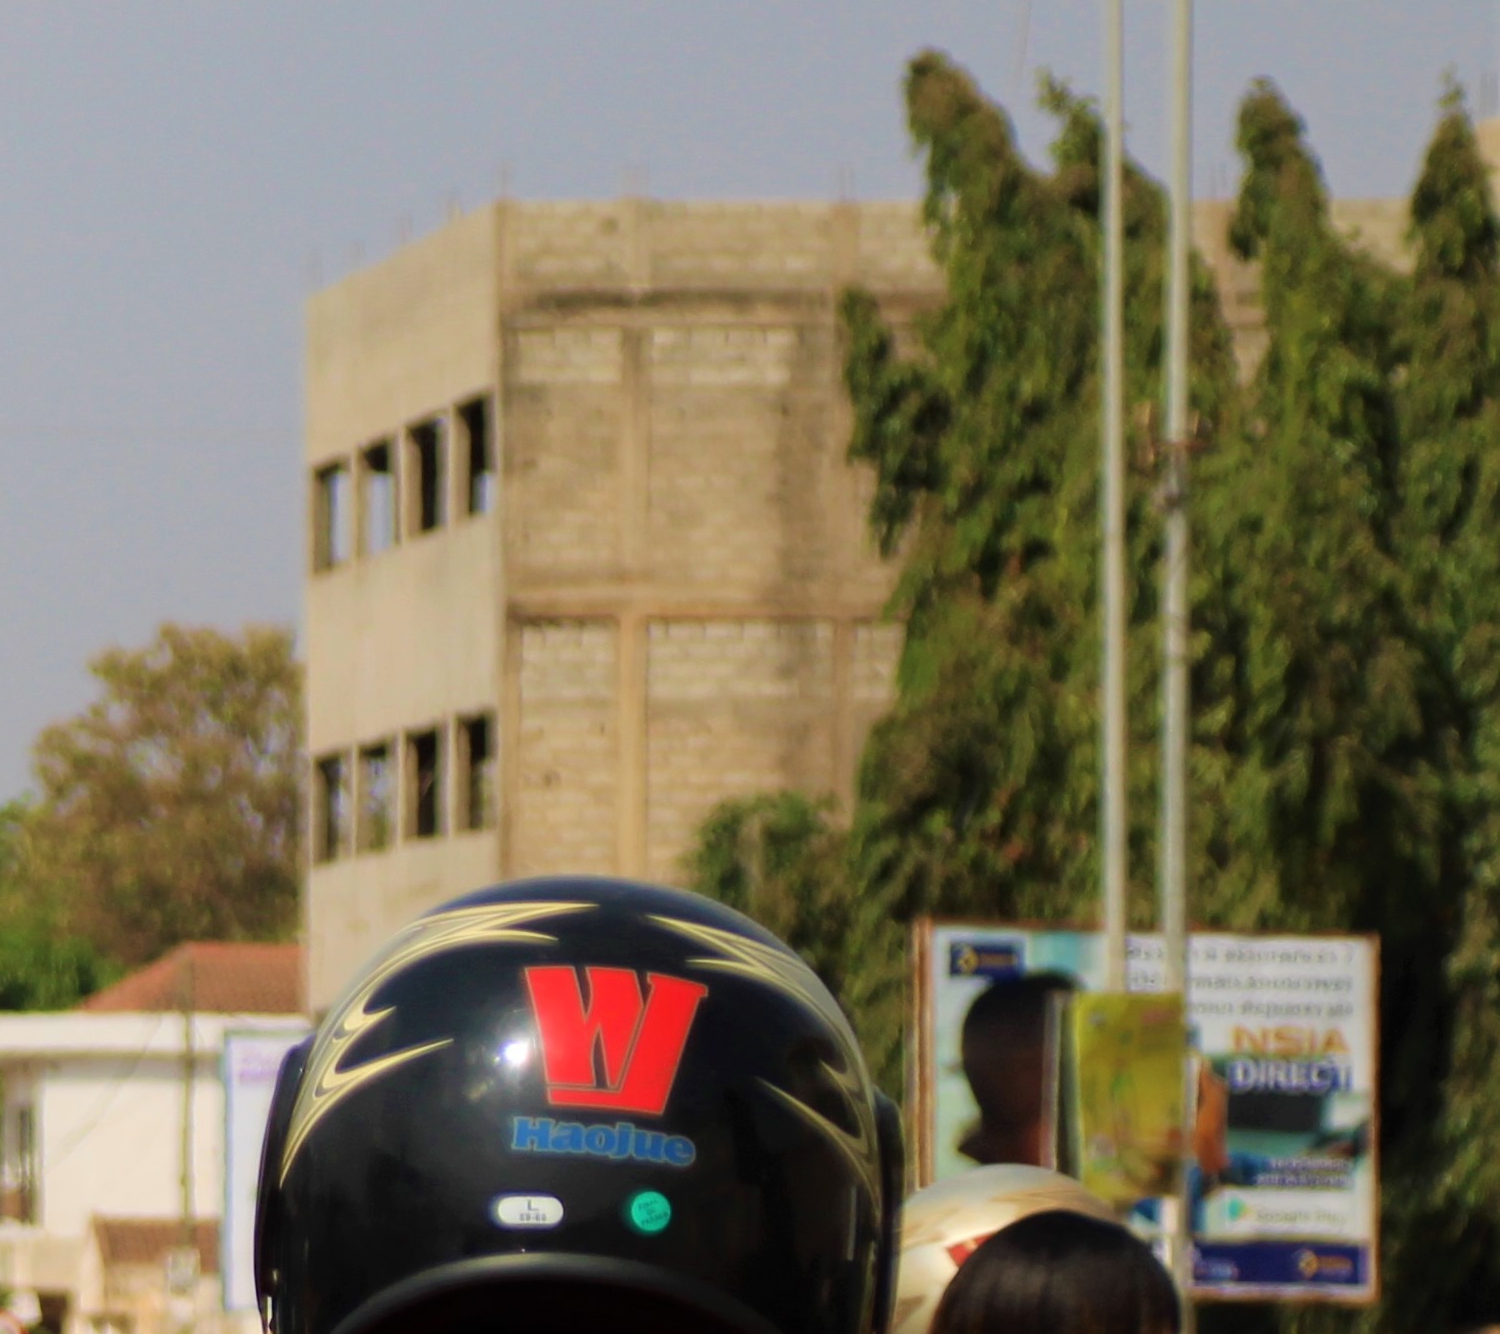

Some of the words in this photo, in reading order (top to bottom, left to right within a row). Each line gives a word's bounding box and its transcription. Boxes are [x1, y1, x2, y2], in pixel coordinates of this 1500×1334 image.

[1230, 1025, 1349, 1054] NSIA
[1228, 1058, 1353, 1093] DIRECT
[512, 1116, 696, 1166] Haojue
